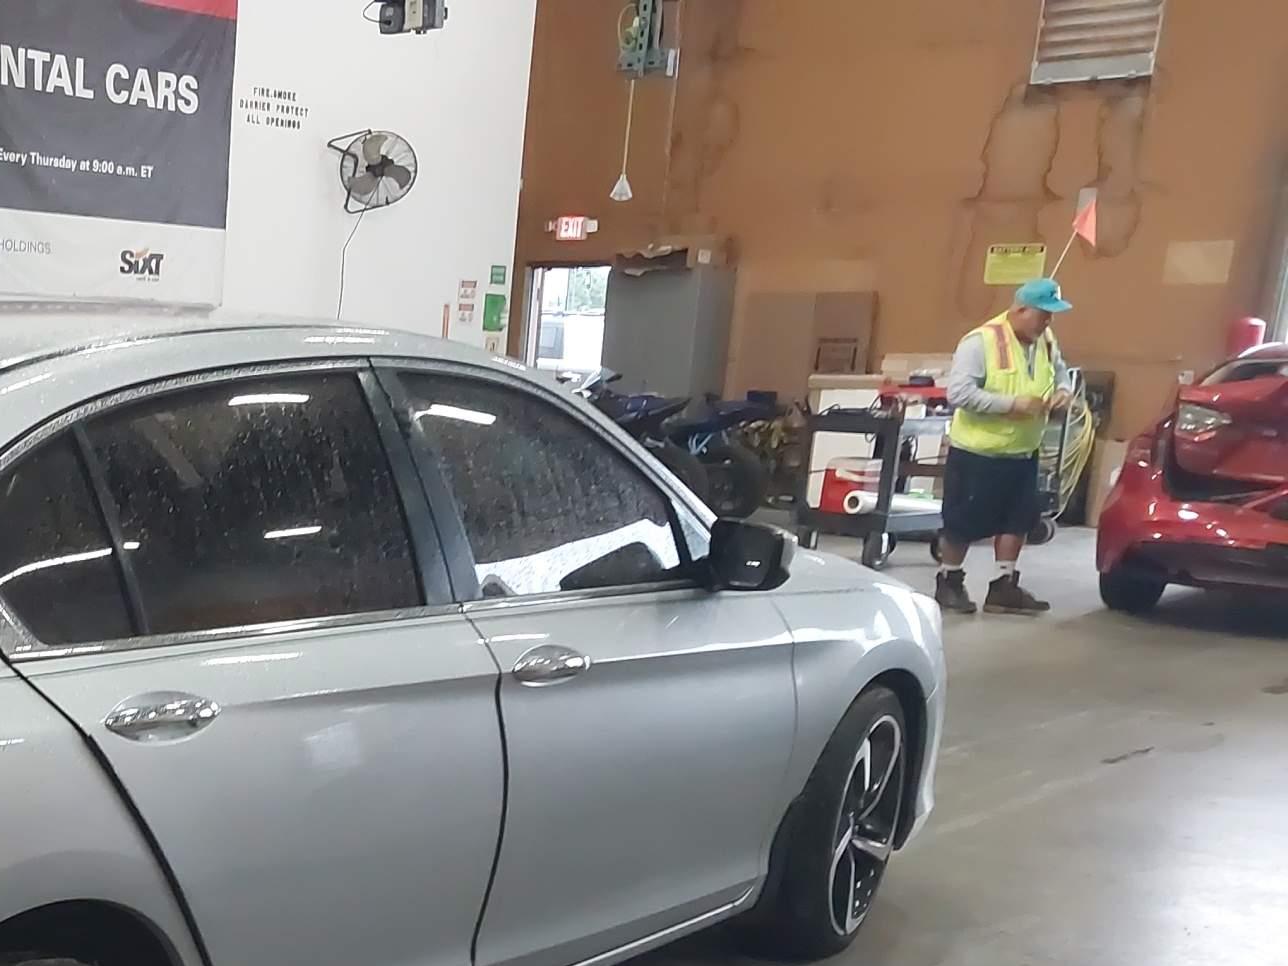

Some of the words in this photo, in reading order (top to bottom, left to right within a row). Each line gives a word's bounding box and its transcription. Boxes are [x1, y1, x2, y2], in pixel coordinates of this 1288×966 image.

[105, 63, 199, 115] CARS
[246, 114, 261, 125] ALL
[29, 151, 78, 172] Thursday
[79, 159, 90, 171] at
[92, 160, 114, 174] 9:00
[116, 165, 138, 177] a.m.
[140, 165, 154, 179] ET
[560, 216, 584, 238] EXIT
